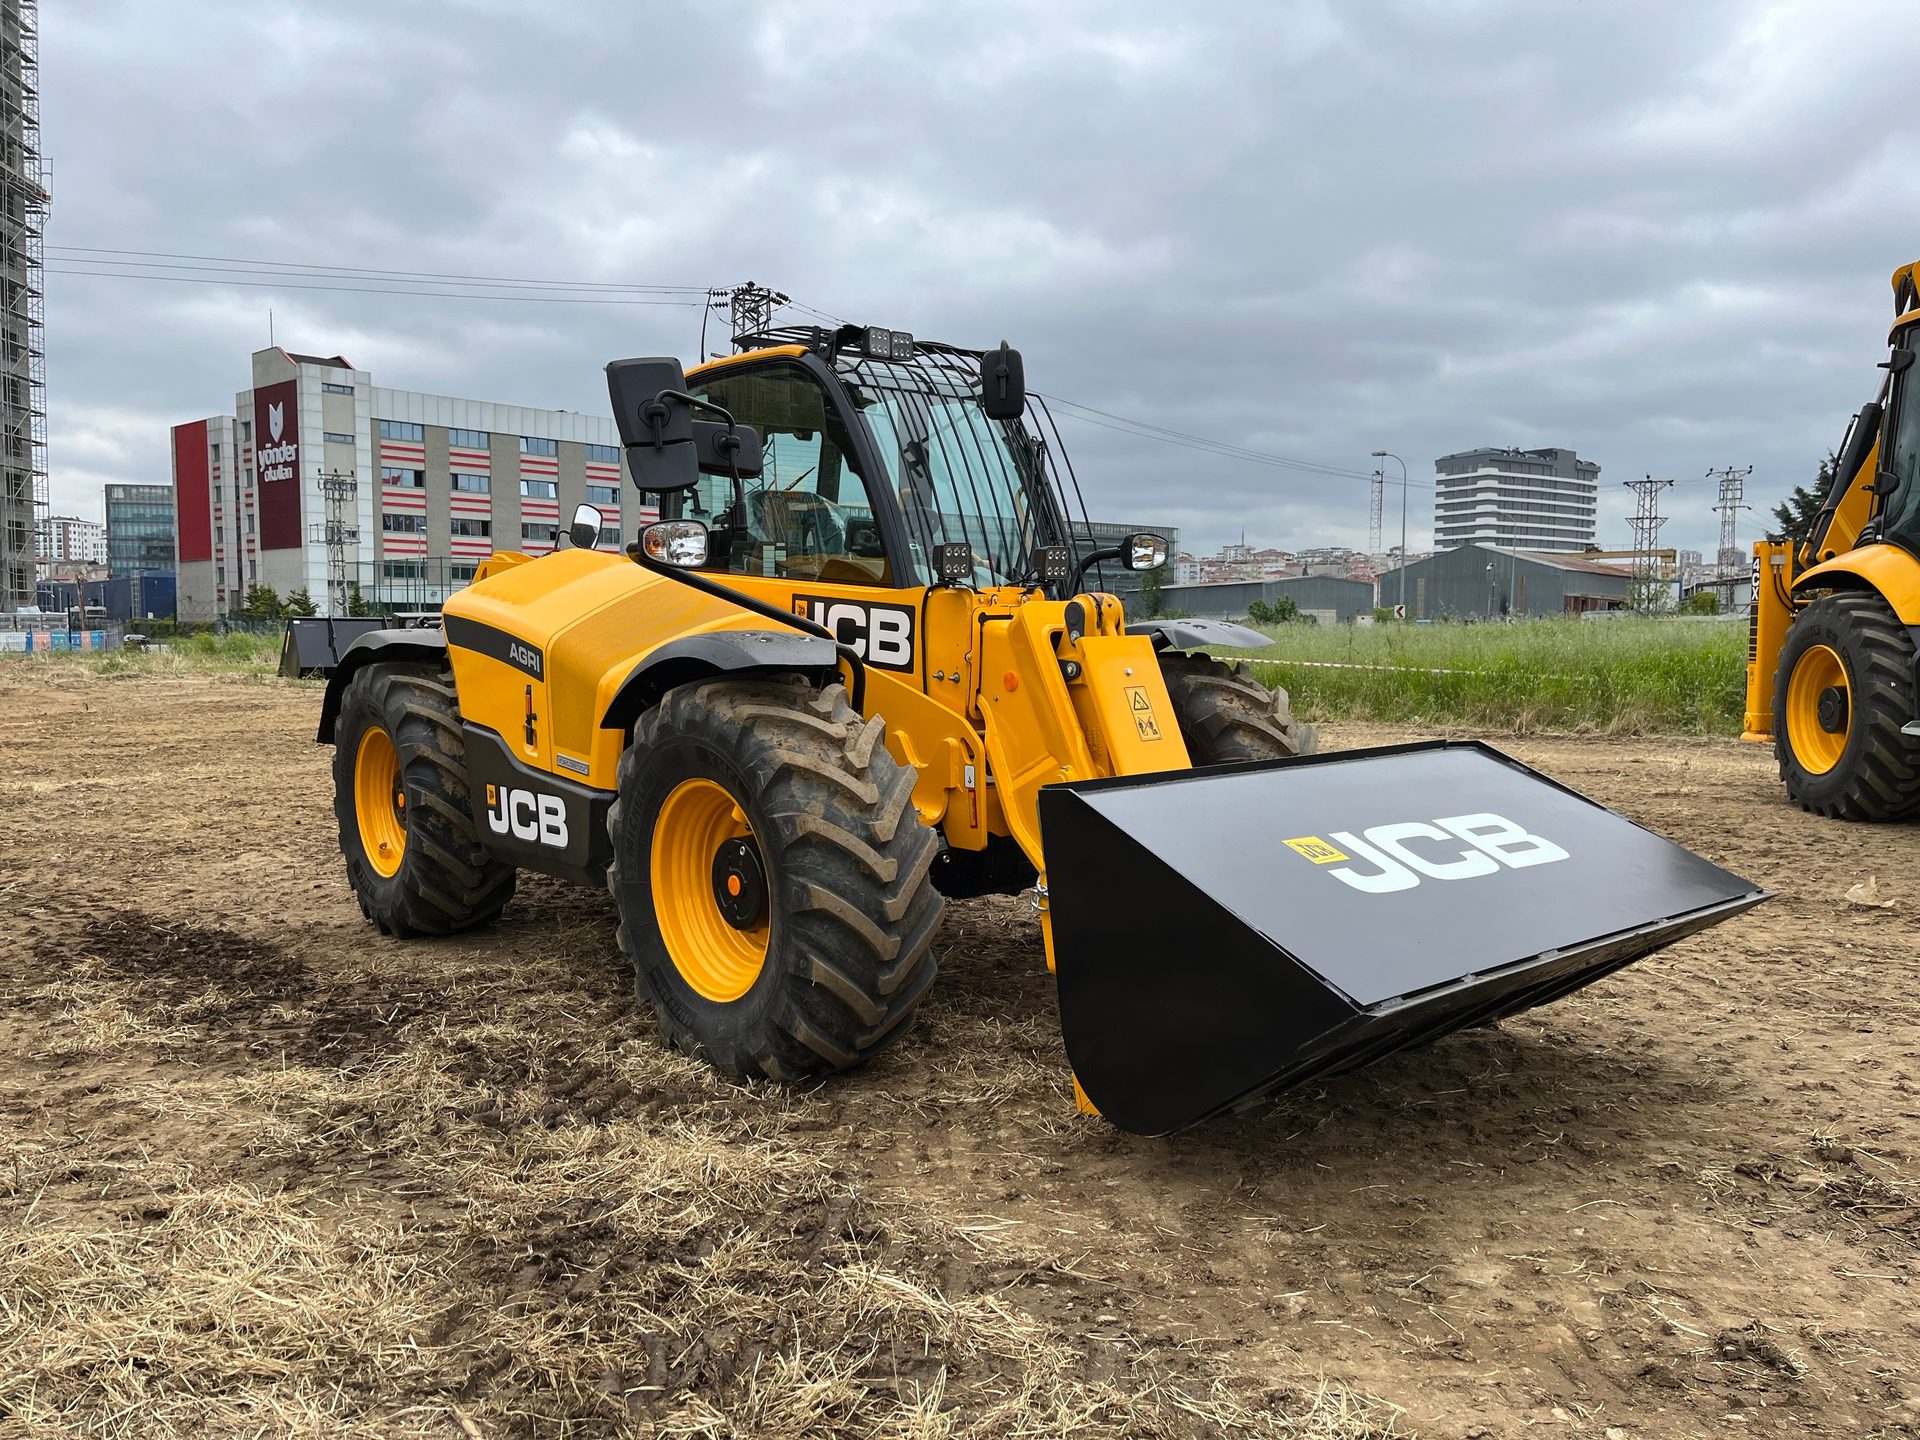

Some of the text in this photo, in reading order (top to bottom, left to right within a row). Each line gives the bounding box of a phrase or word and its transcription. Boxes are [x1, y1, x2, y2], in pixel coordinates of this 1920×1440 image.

[258, 440, 298, 472] yönder
[1751, 558, 1760, 600] 4CX
[509, 642, 541, 673] AGRI
[487, 786, 569, 849] JCB
[1327, 812, 1570, 893] JCB
